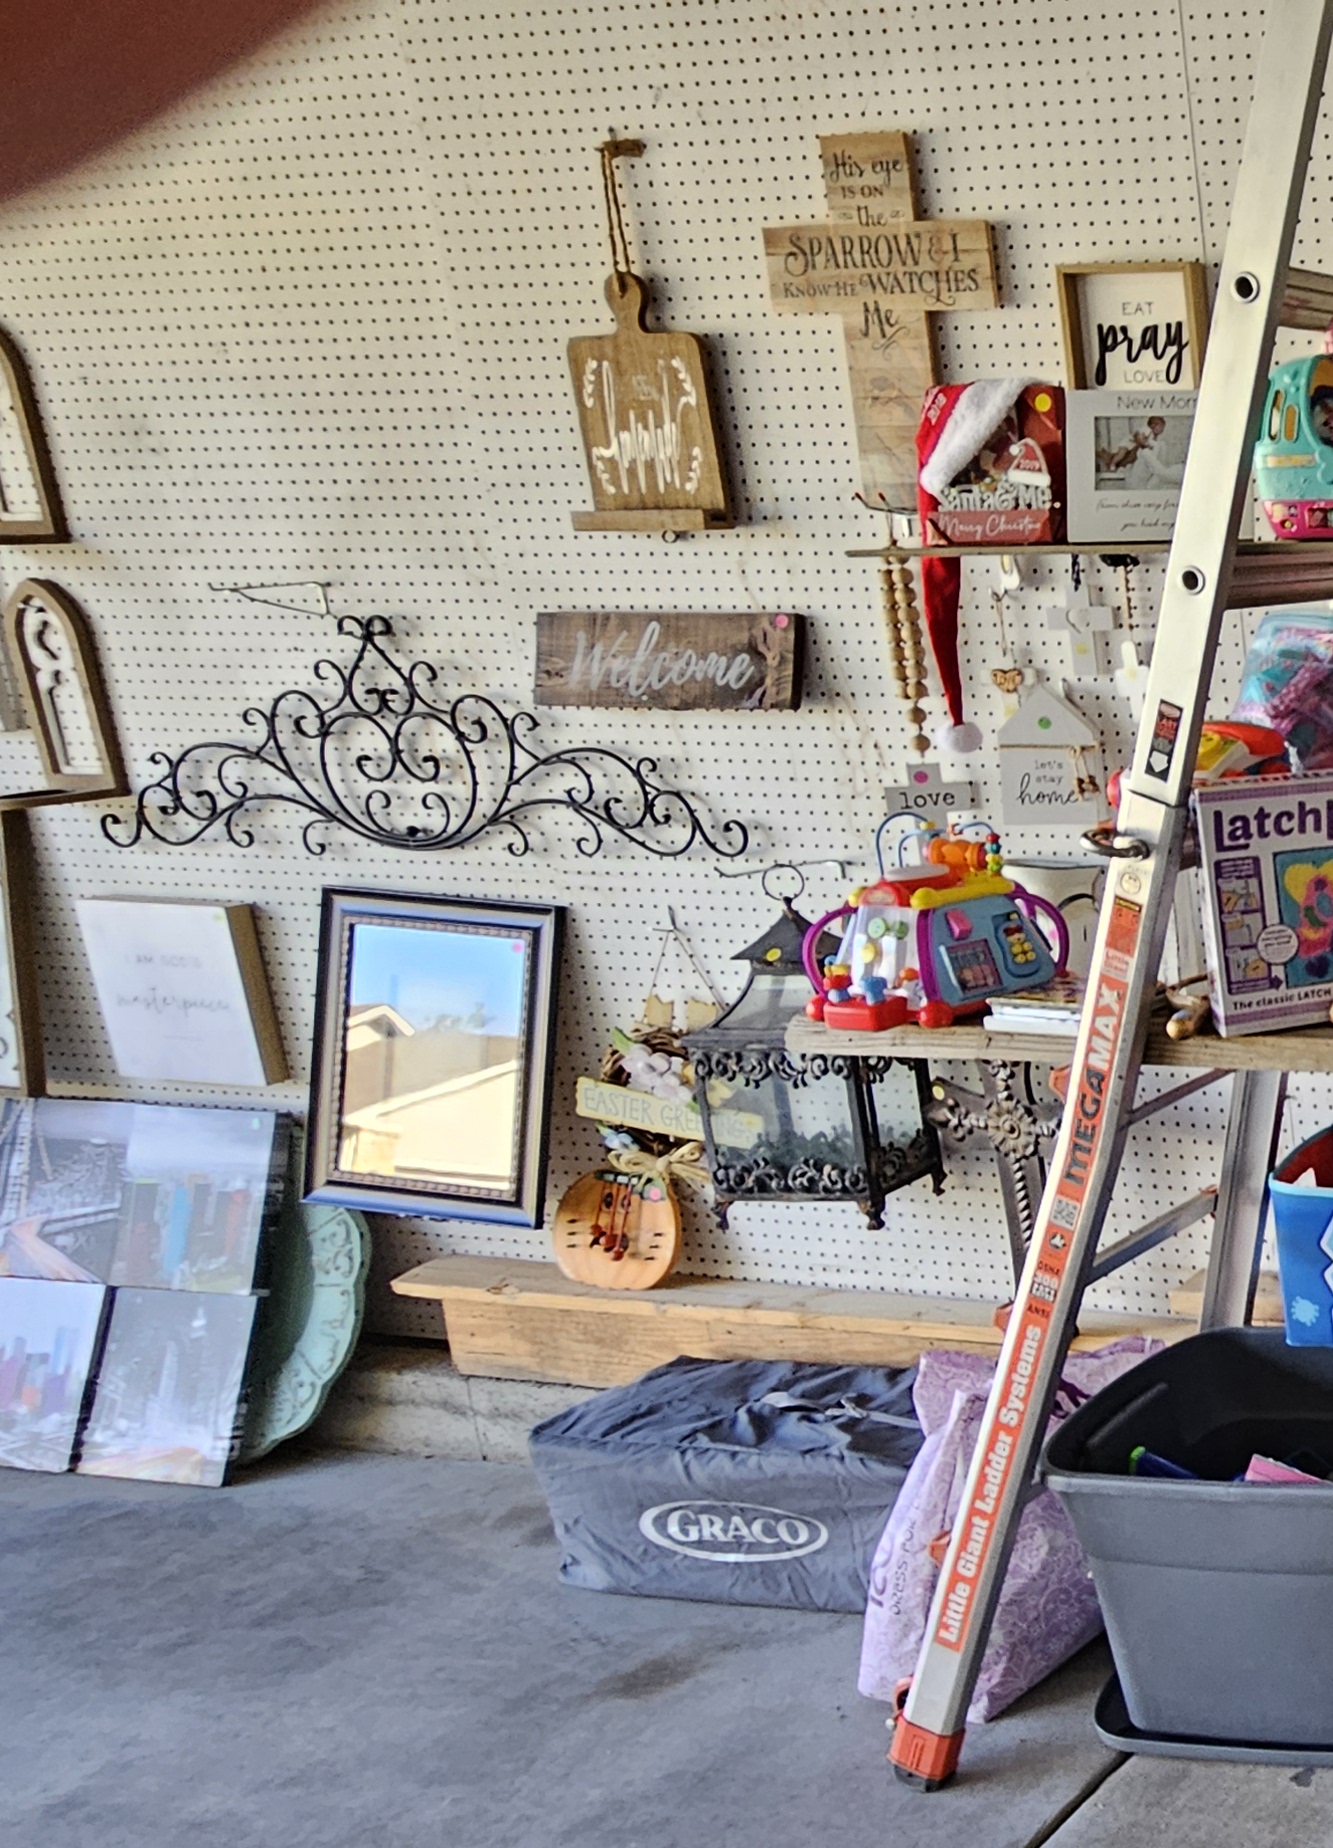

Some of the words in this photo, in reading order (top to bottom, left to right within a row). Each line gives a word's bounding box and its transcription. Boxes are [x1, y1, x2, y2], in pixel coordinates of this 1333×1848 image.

[830, 150, 865, 183] His
[871, 157, 904, 187] eye
[841, 185, 856, 199] IS
[860, 184, 884, 198] ON
[856, 205, 888, 227] the
[784, 233, 922, 277] SPARROW
[858, 266, 980, 306] WATCHES
[859, 300, 899, 339] Me
[1121, 301, 1155, 316] EAT
[1095, 320, 1190, 387] pray
[1123, 369, 1165, 384] LOVE
[1117, 395, 1156, 410] New
[567, 621, 755, 697] Welcome
[1034, 759, 1064, 771] let's
[1035, 775, 1064, 785] stay
[899, 791, 956, 810] love
[1016, 772, 1079, 807] home
[1232, 1000, 1253, 1011] The
[1255, 994, 1296, 1008] classic
[1297, 987, 1333, 1002] LATCH
[583, 1087, 654, 1126] EASTER
[660, 1105, 748, 1141] GREEING
[938, 1580, 971, 1643] Little
[957, 1518, 989, 1578] Giant
[975, 1431, 1013, 1515] Ladder
[999, 1324, 1042, 1427] Systems
[667, 1509, 809, 1545] GRACO
